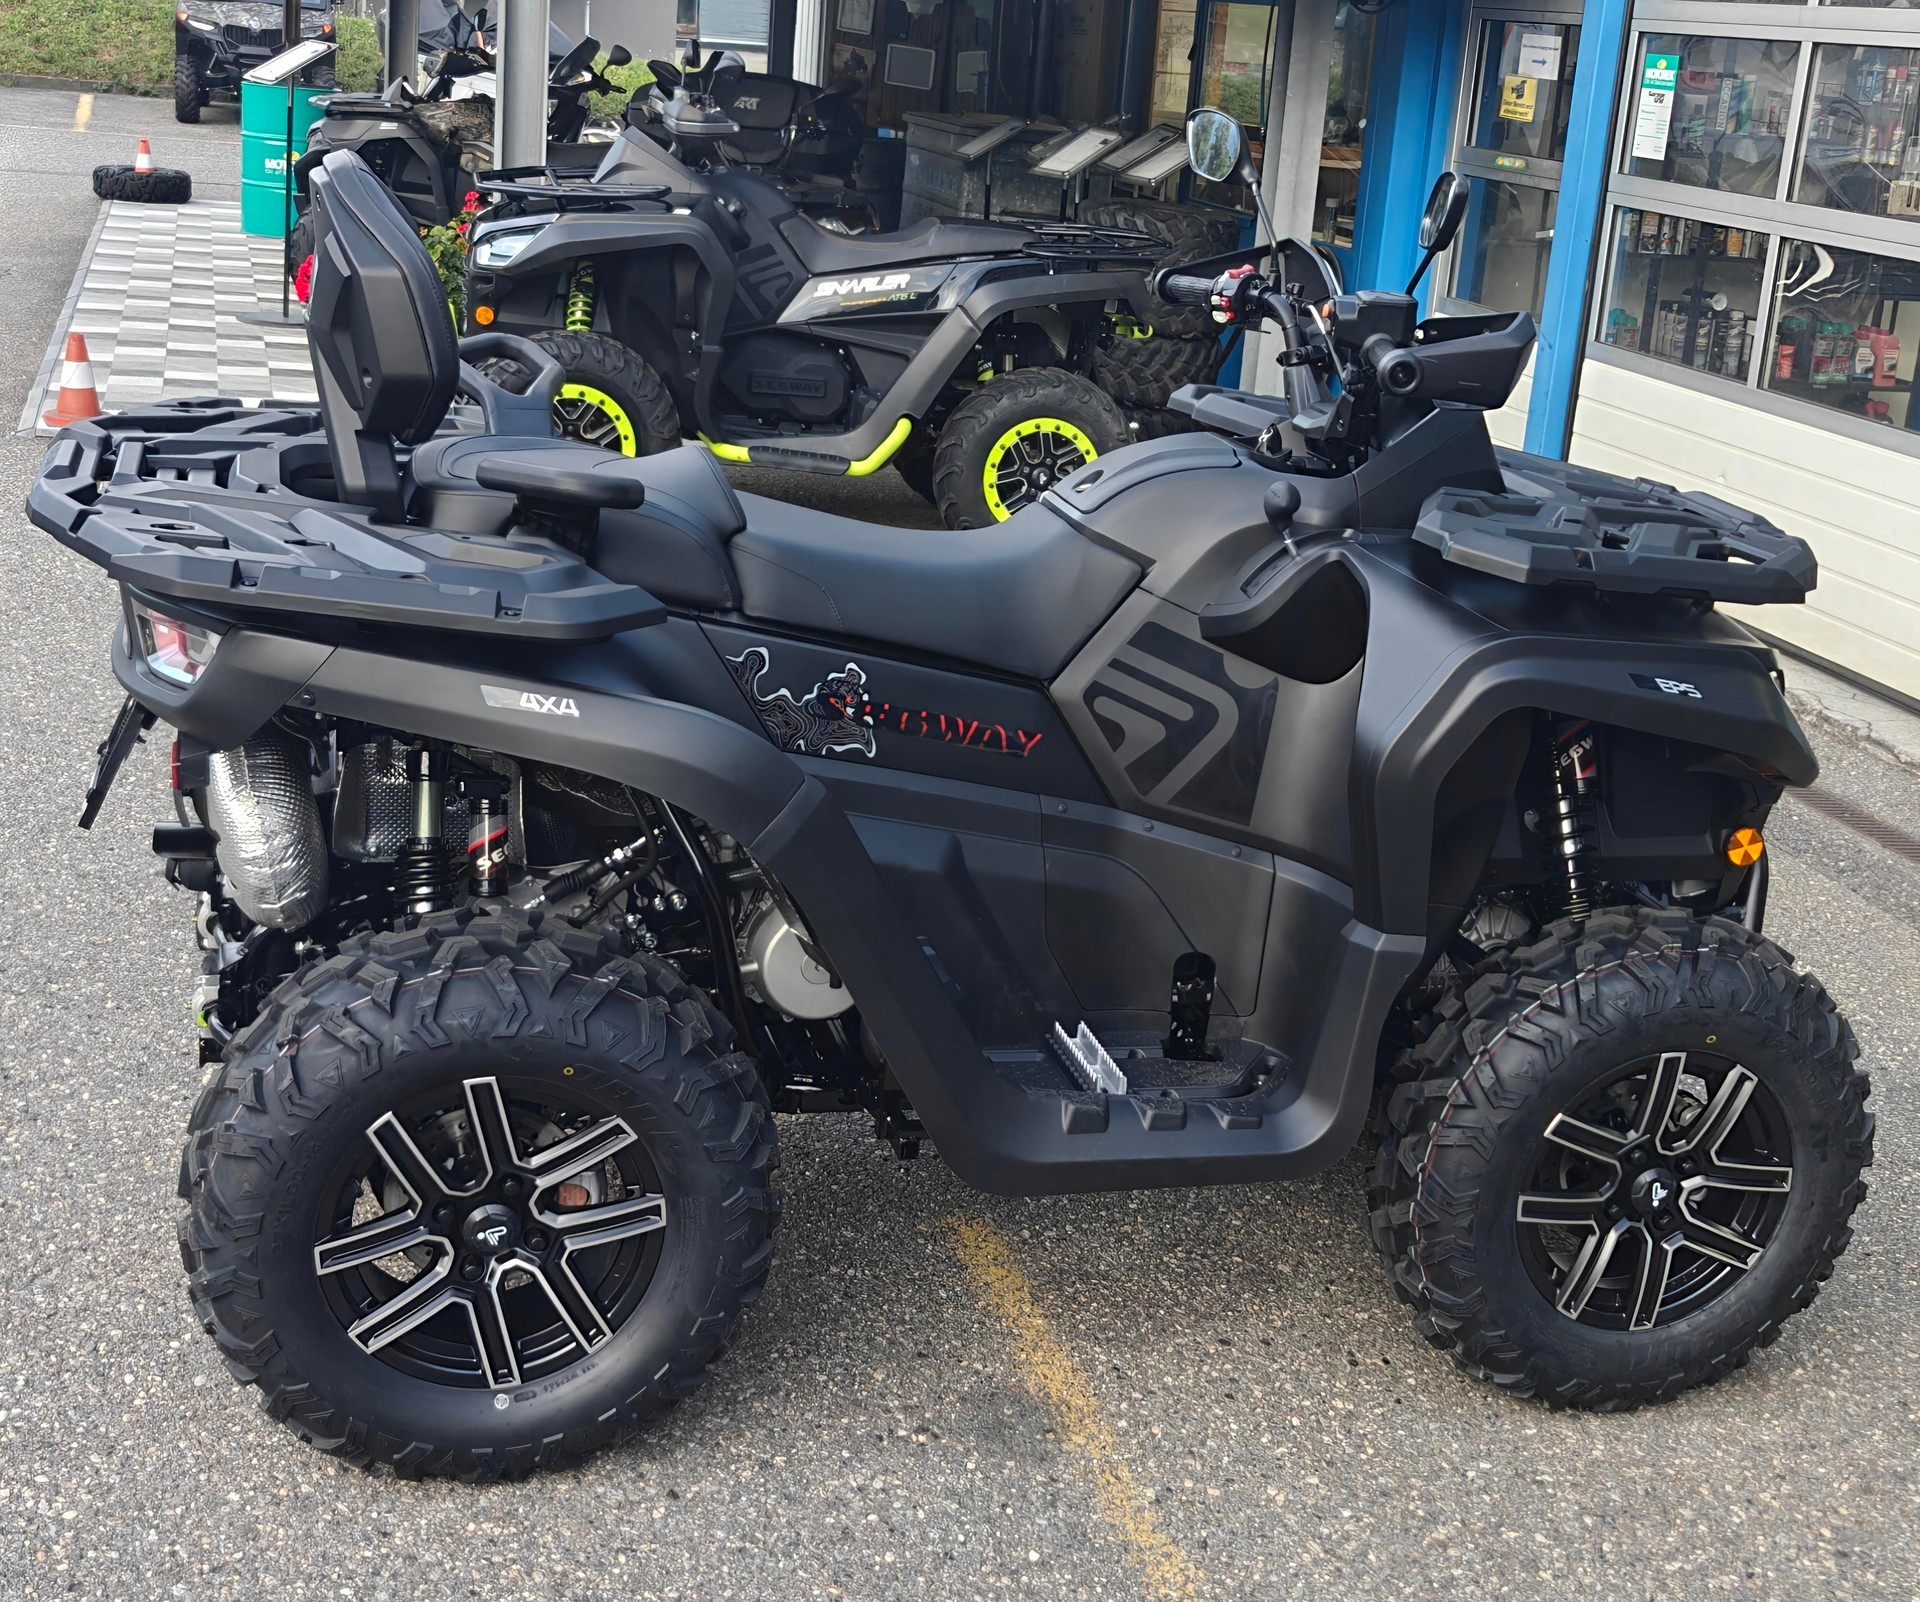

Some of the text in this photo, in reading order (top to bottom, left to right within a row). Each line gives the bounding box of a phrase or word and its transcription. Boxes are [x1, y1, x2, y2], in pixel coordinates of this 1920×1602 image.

[813, 273, 911, 298] SNARLER
[1654, 677, 1703, 699] EPS
[476, 841, 511, 872] SE
